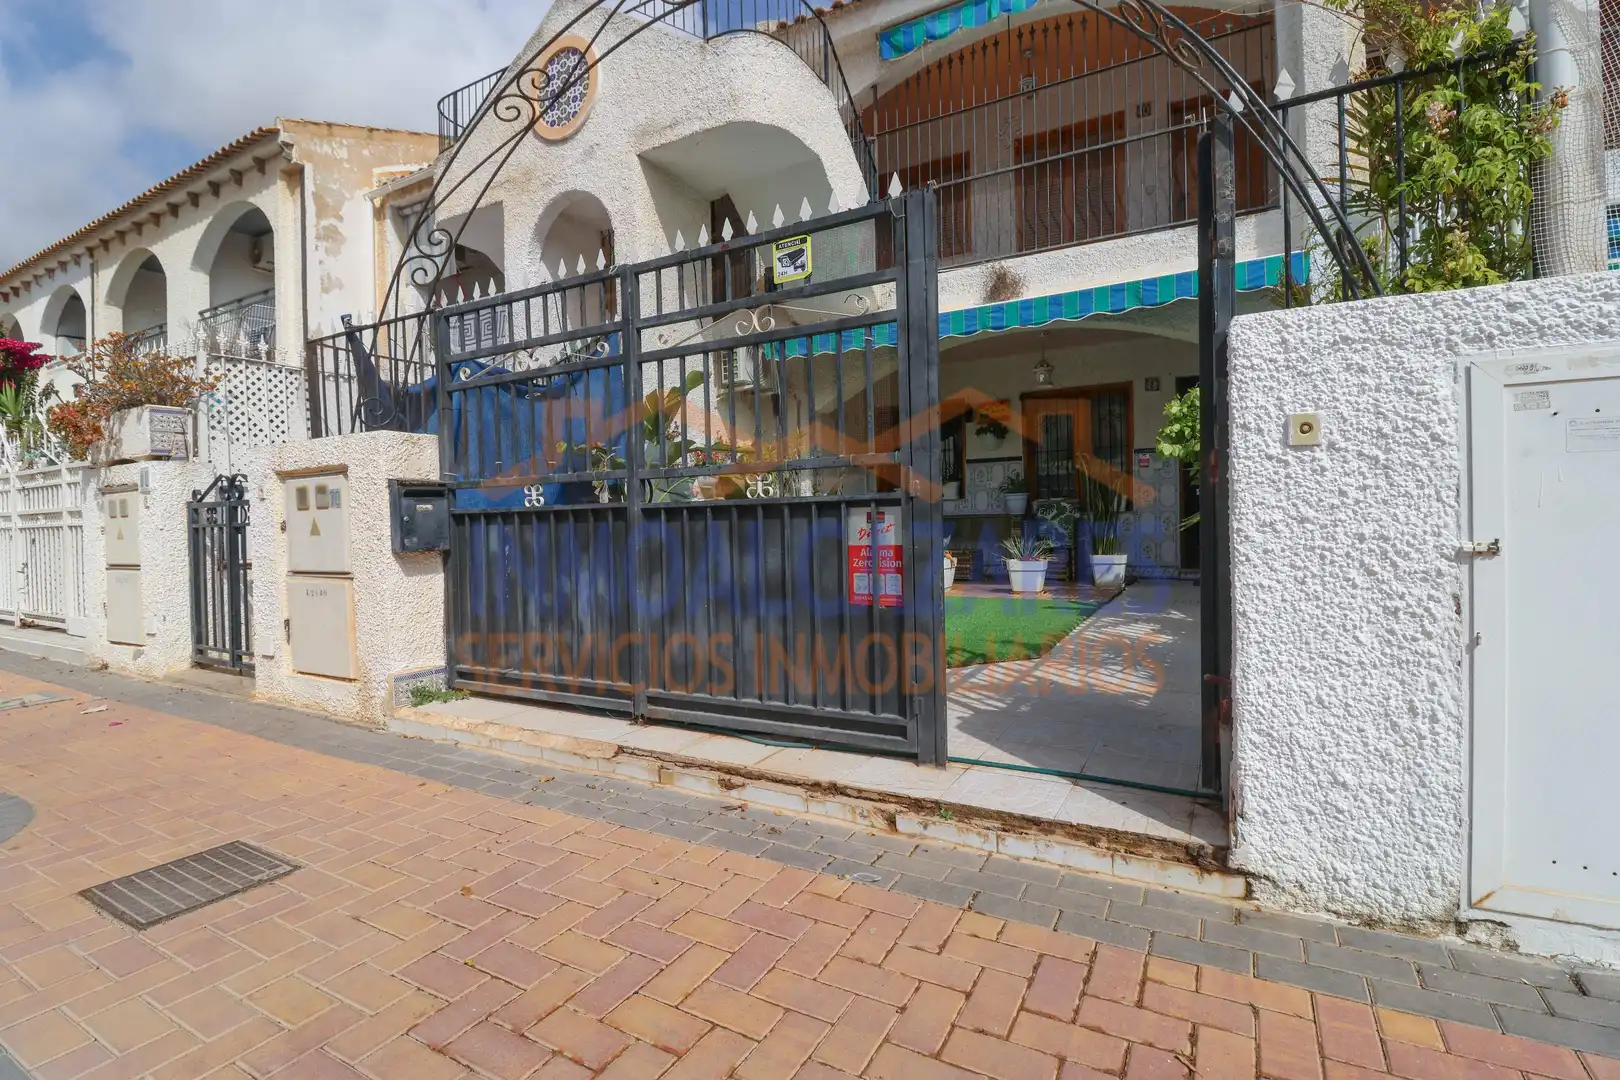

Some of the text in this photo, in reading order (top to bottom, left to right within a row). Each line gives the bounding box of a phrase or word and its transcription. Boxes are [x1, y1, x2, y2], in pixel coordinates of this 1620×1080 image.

[857, 523, 896, 541] Dict
[860, 547, 893, 557] Alama
[852, 557, 902, 568] Zeroision
